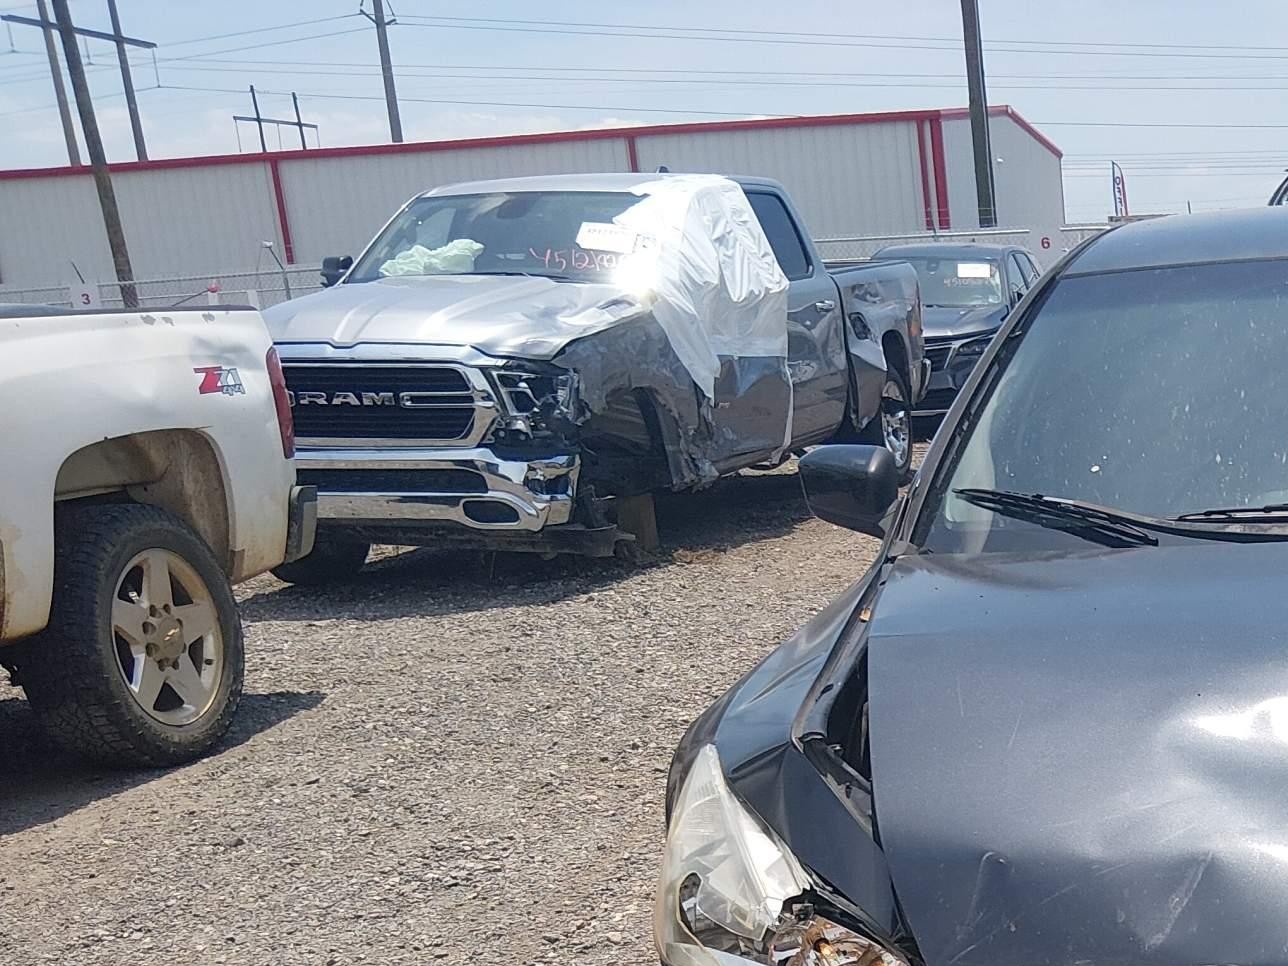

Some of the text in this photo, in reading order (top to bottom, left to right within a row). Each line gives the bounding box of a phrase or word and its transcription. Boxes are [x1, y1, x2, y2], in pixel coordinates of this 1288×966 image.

[1041, 237, 1050, 249] 6
[81, 293, 91, 305] 3
[298, 391, 396, 406] RAM
